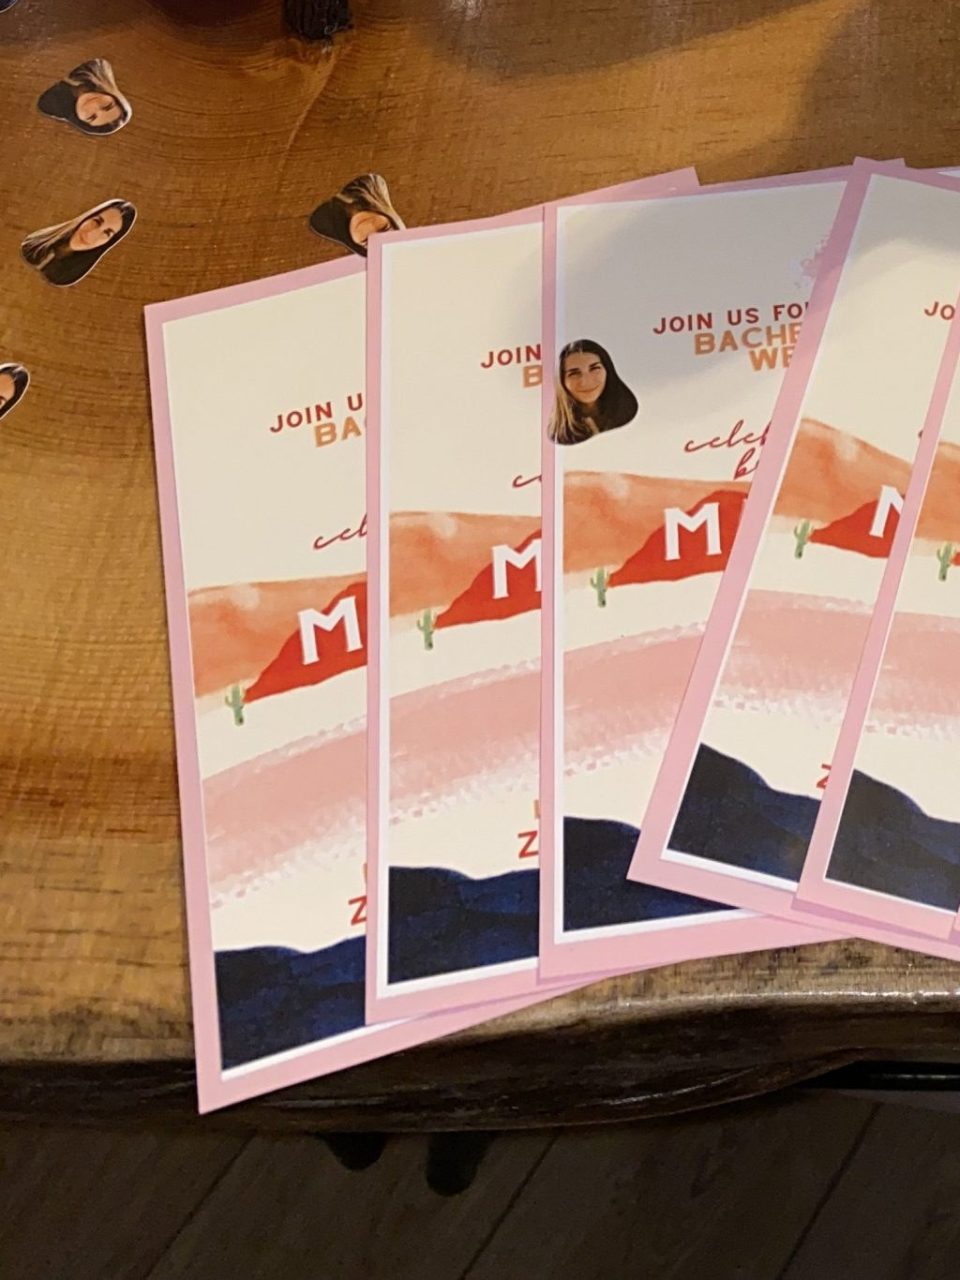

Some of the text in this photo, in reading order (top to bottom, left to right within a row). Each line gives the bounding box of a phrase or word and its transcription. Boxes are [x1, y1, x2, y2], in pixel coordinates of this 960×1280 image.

[652, 301, 810, 335] JOIN US FO
[480, 343, 542, 369] JOIN
[269, 401, 333, 434] JOIN
